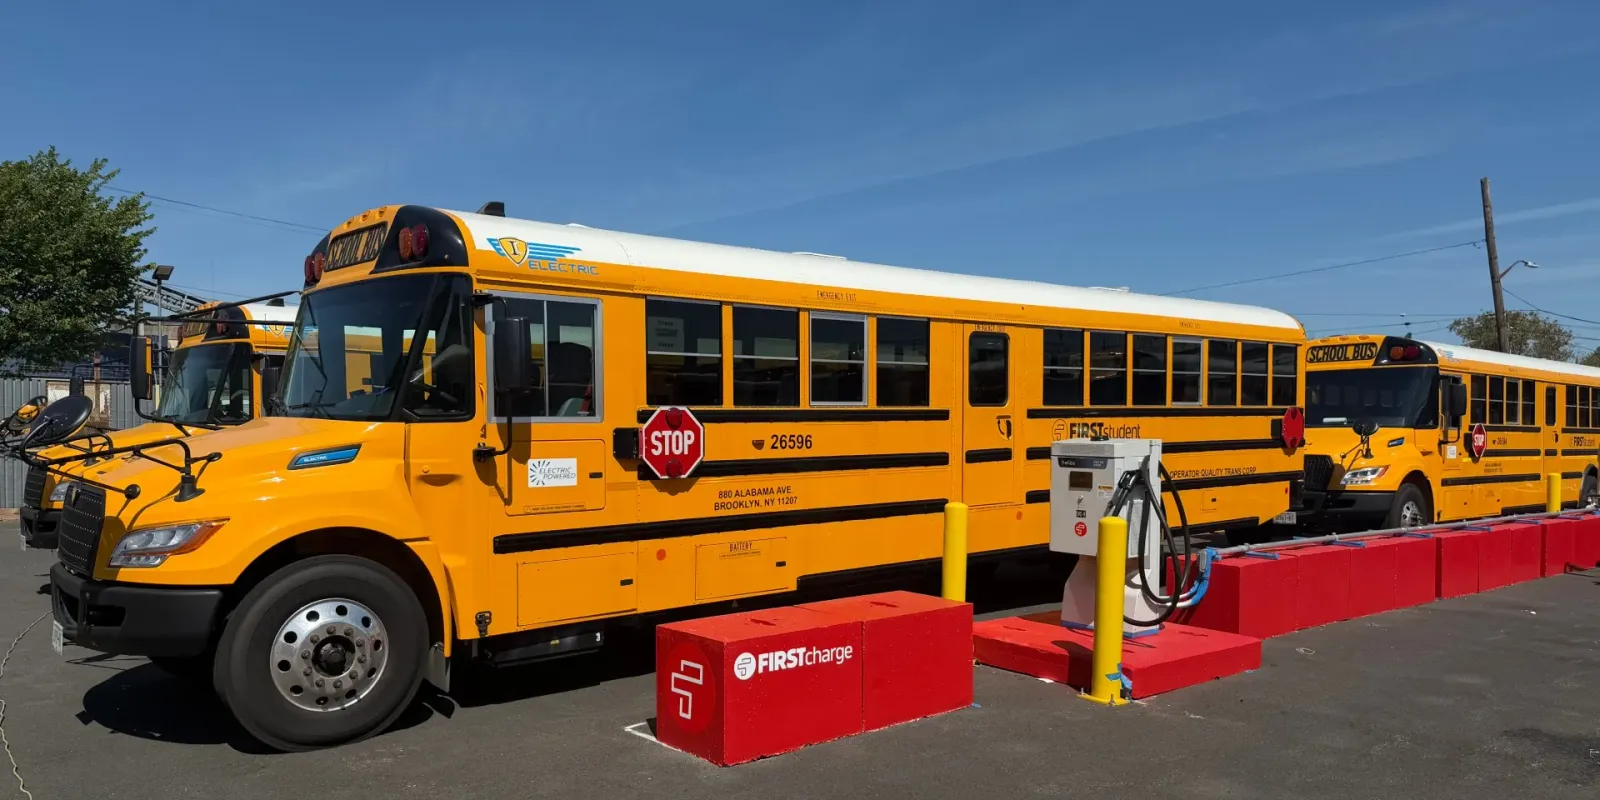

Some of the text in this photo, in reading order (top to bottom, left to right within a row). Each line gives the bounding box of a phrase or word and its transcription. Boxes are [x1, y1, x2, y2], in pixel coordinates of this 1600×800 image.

[326, 224, 387, 267] SCHOOL BUS
[509, 240, 521, 256] I
[528, 260, 599, 275] ELECTRIC
[1308, 343, 1375, 362] SCHOOL BUS
[651, 430, 695, 456] STOP
[771, 434, 813, 450] 26596
[1474, 434, 1485, 447] STOP
[539, 467, 572, 475] ELECTRIC
[1169, 466, 1257, 479] OPERATOR QUALITY TRANS CORP
[718, 485, 792, 499] 880 ALABAMA AVE
[714, 496, 798, 511] BROOKLYN, NY 11207
[729, 541, 753, 552] BATTERY
[758, 645, 853, 674] FIRSTcharge
